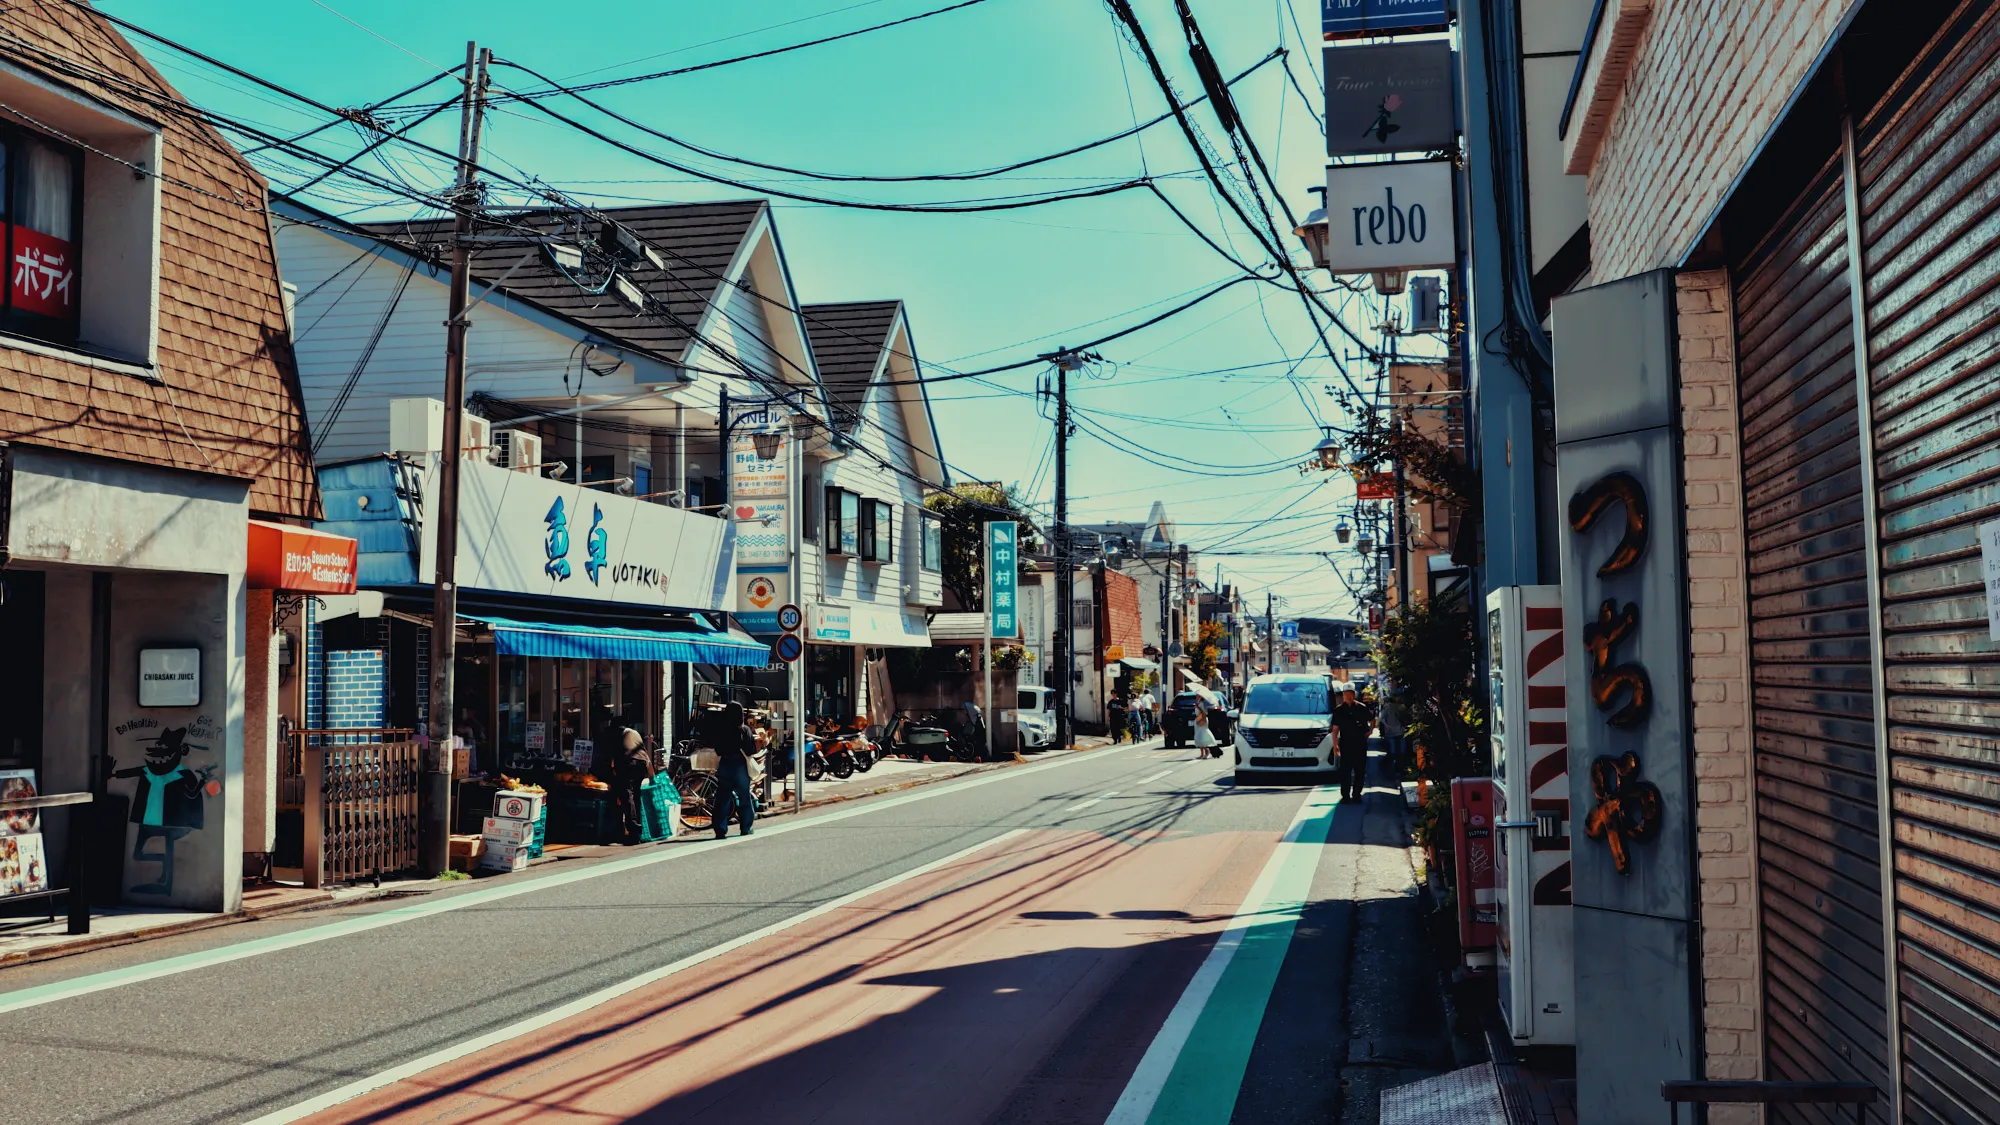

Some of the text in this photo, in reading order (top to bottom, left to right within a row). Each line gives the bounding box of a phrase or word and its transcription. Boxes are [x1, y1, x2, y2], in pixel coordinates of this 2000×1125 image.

[1352, 186, 1427, 246] rebo
[14, 246, 73, 306] ボディ
[747, 463, 784, 473] セミナー
[311, 550, 349, 568] Beauty School
[316, 566, 339, 584] Esthetic
[338, 569, 353, 584] Salon
[612, 562, 660, 590] UOTAKU
[995, 548, 1012, 629] 中村薬局
[782, 611, 798, 625] 30
[143, 672, 195, 681] CHIGASAKI JUICE
[115, 718, 158, 735] Be Healthy
[197, 715, 213, 727] Got
